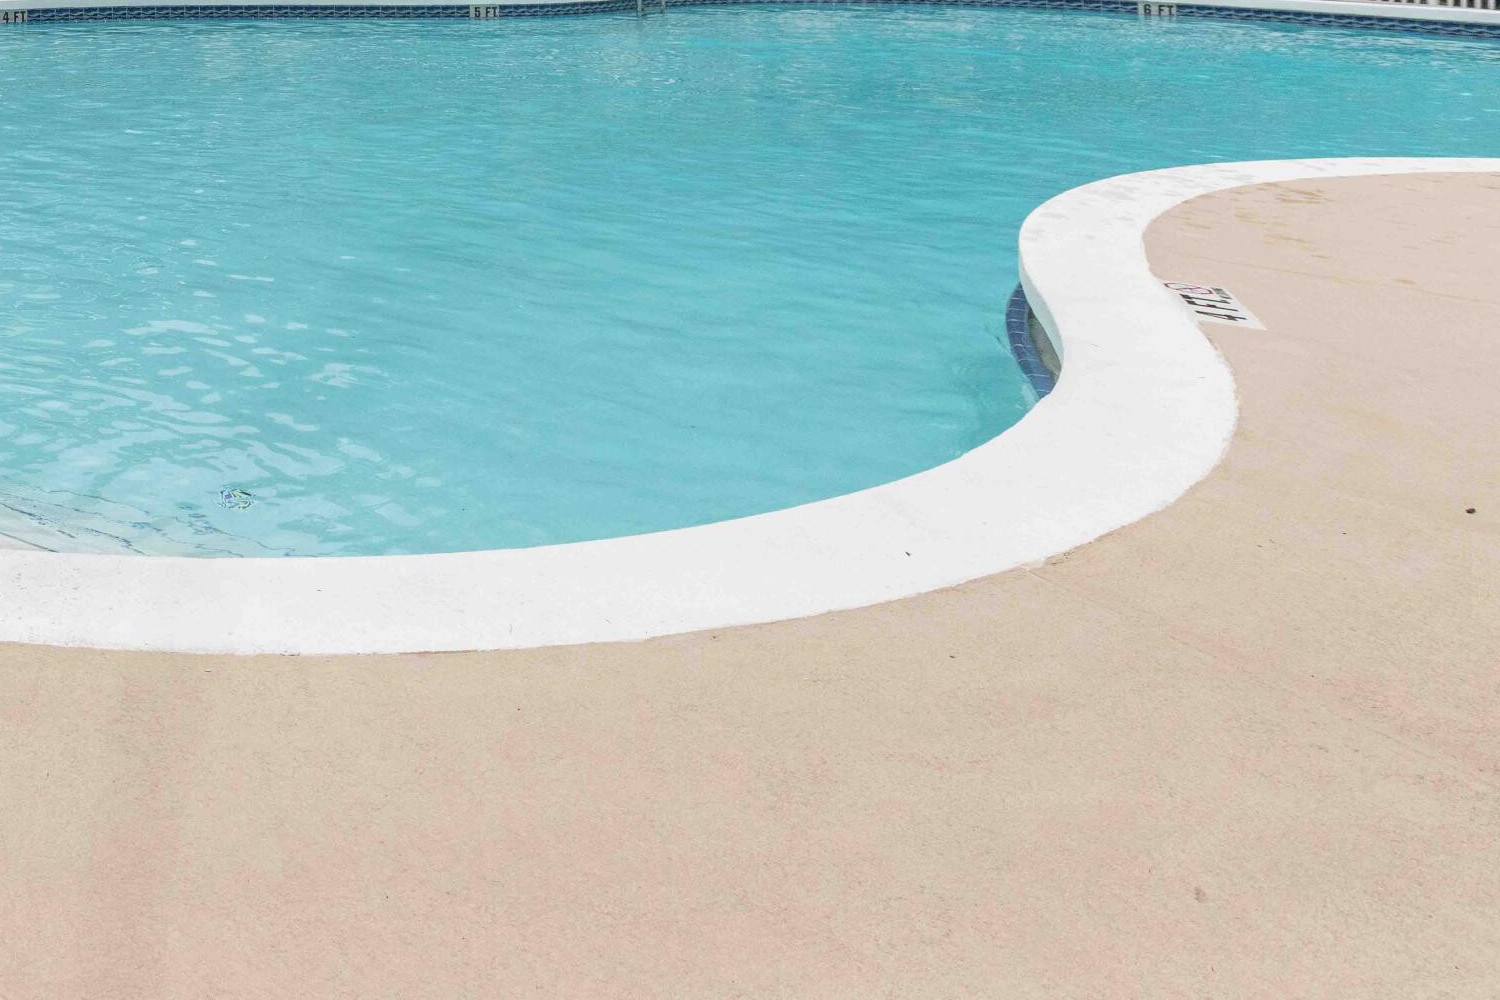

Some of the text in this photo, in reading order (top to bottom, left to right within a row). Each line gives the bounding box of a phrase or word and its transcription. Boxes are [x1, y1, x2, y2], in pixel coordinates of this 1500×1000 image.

[474, 6, 481, 18] 5
[1143, 3, 1152, 15] 6
[2, 11, 10, 24] 4
